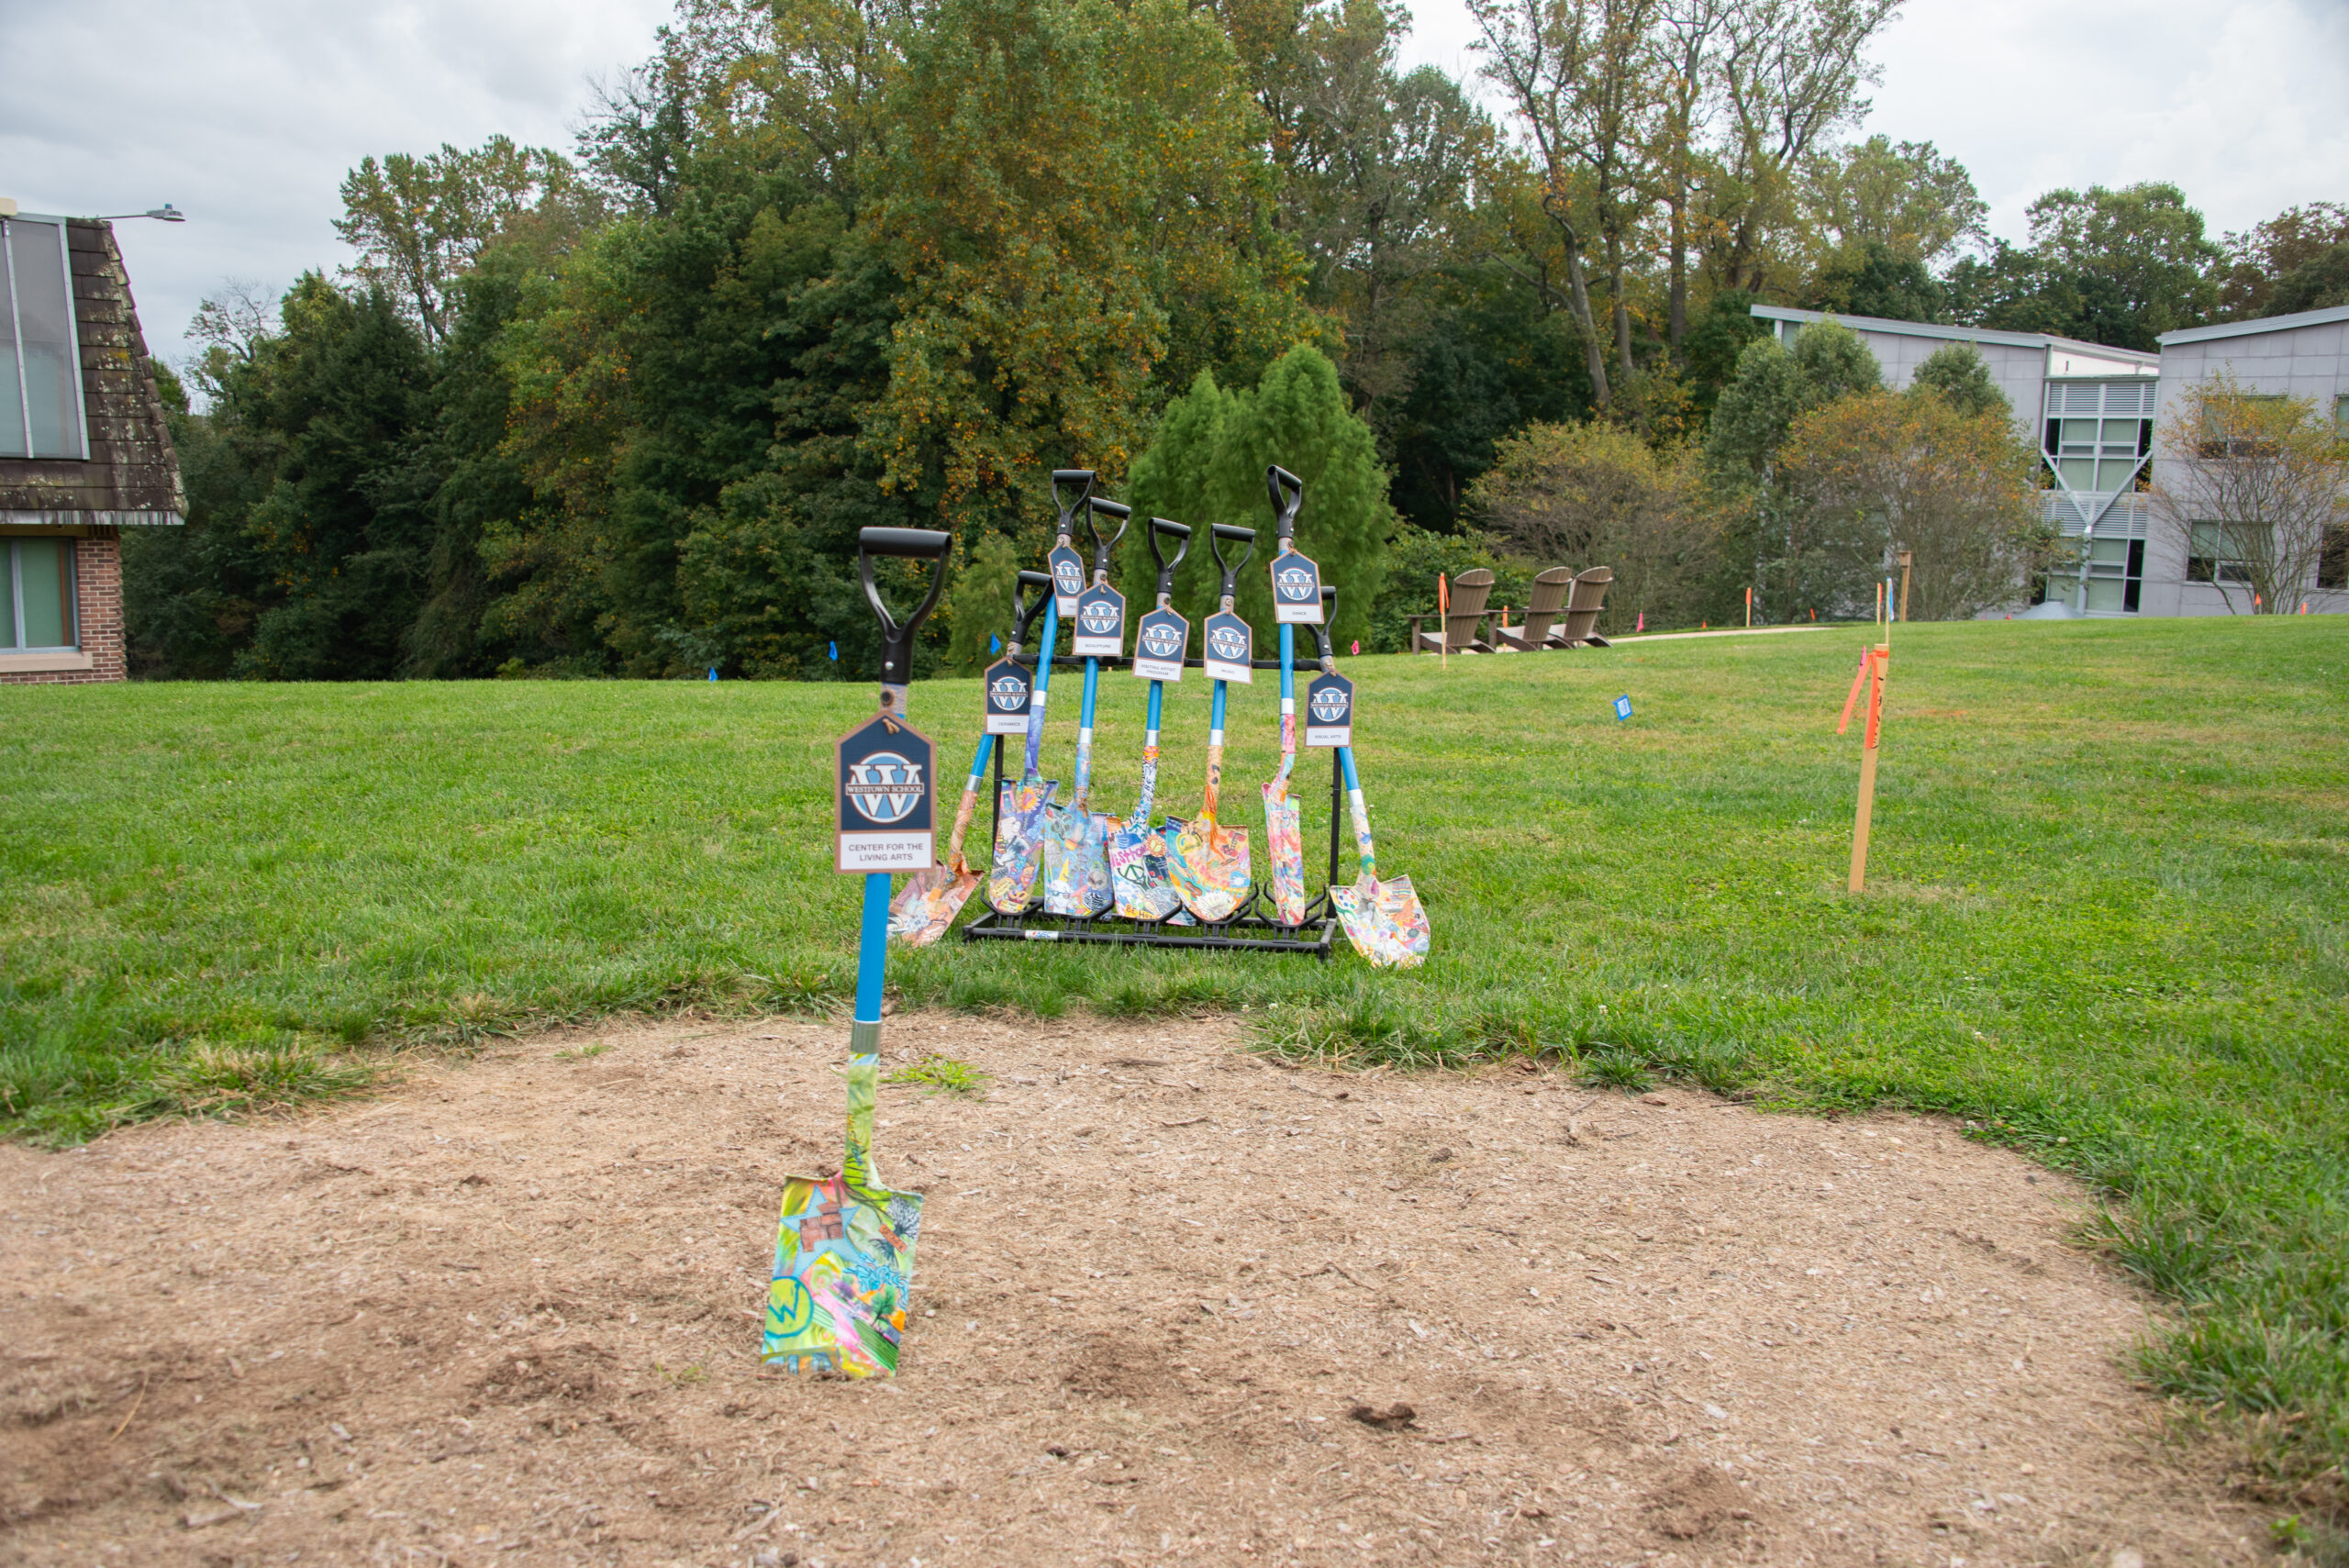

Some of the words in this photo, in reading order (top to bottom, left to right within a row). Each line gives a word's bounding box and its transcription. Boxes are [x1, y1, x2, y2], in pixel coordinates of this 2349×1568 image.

[847, 784, 891, 794] WESTTOWN
[892, 784, 922, 794] SCHOOL
[849, 763, 923, 817] W
[848, 843, 884, 851] CENTER
[907, 842, 924, 851] THE
[859, 853, 888, 862] LIVING
